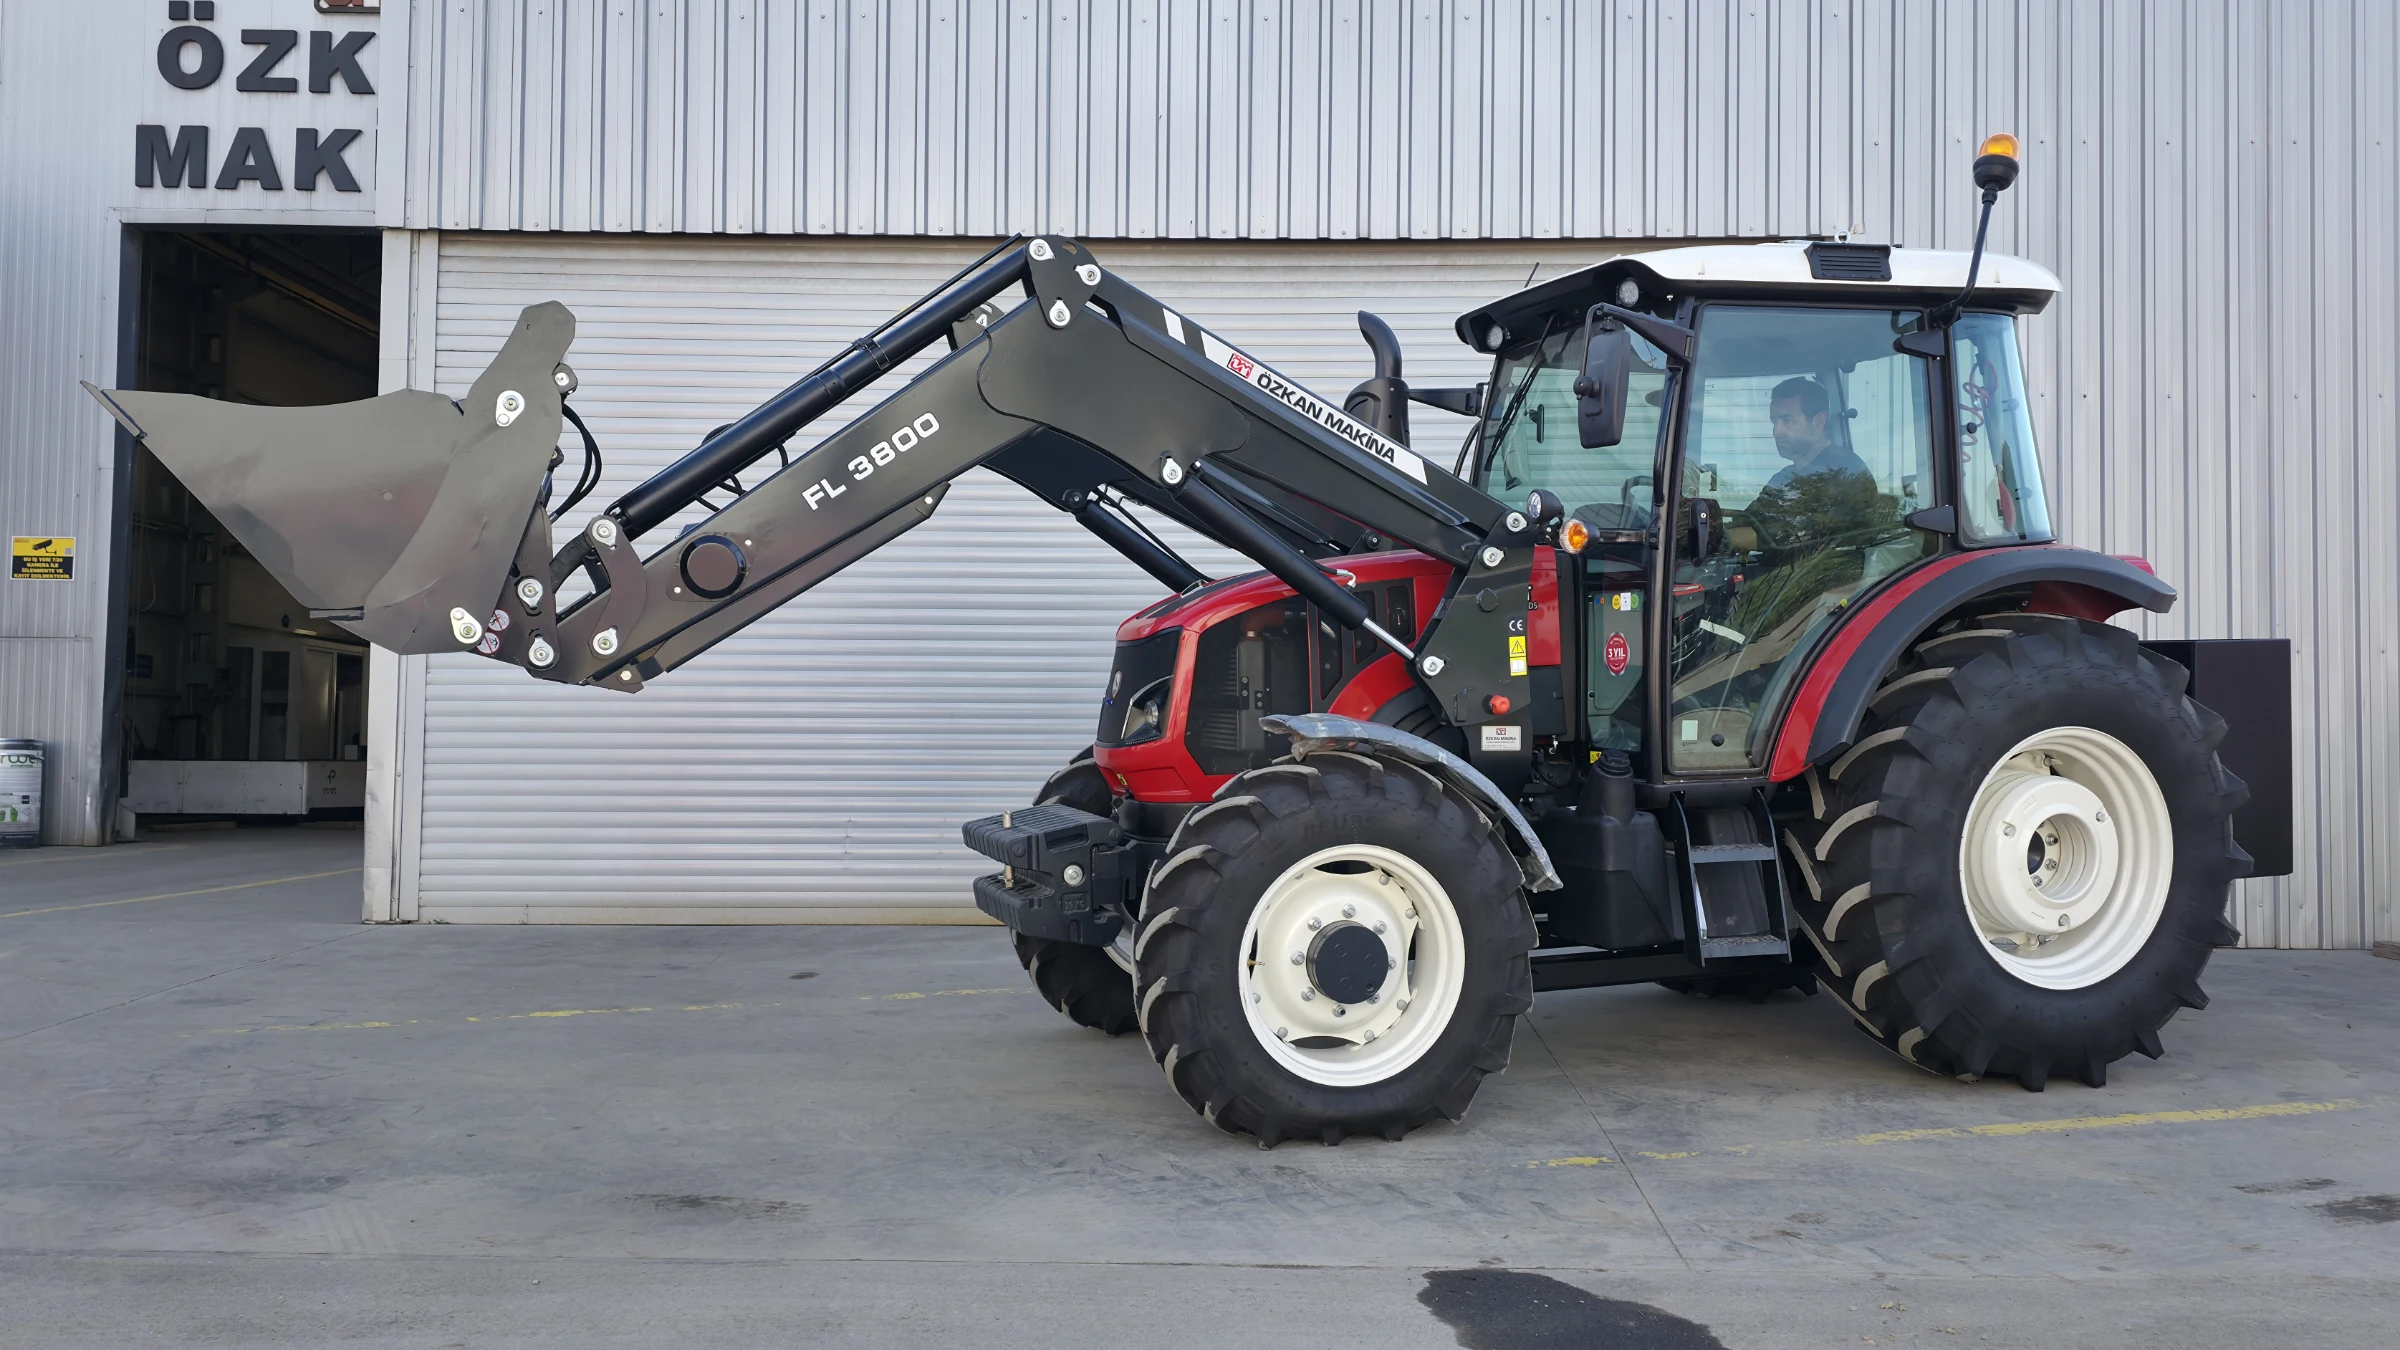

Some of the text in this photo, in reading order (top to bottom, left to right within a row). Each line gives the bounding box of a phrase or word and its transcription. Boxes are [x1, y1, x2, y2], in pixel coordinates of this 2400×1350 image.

[157, 0, 377, 95] ÖZK
[801, 412, 940, 511] FL 3800
[1256, 372, 1396, 464] ÖZKAN MAKİNA
[1509, 620, 1523, 631] CE
[1608, 647, 1626, 658] 3 YIL
